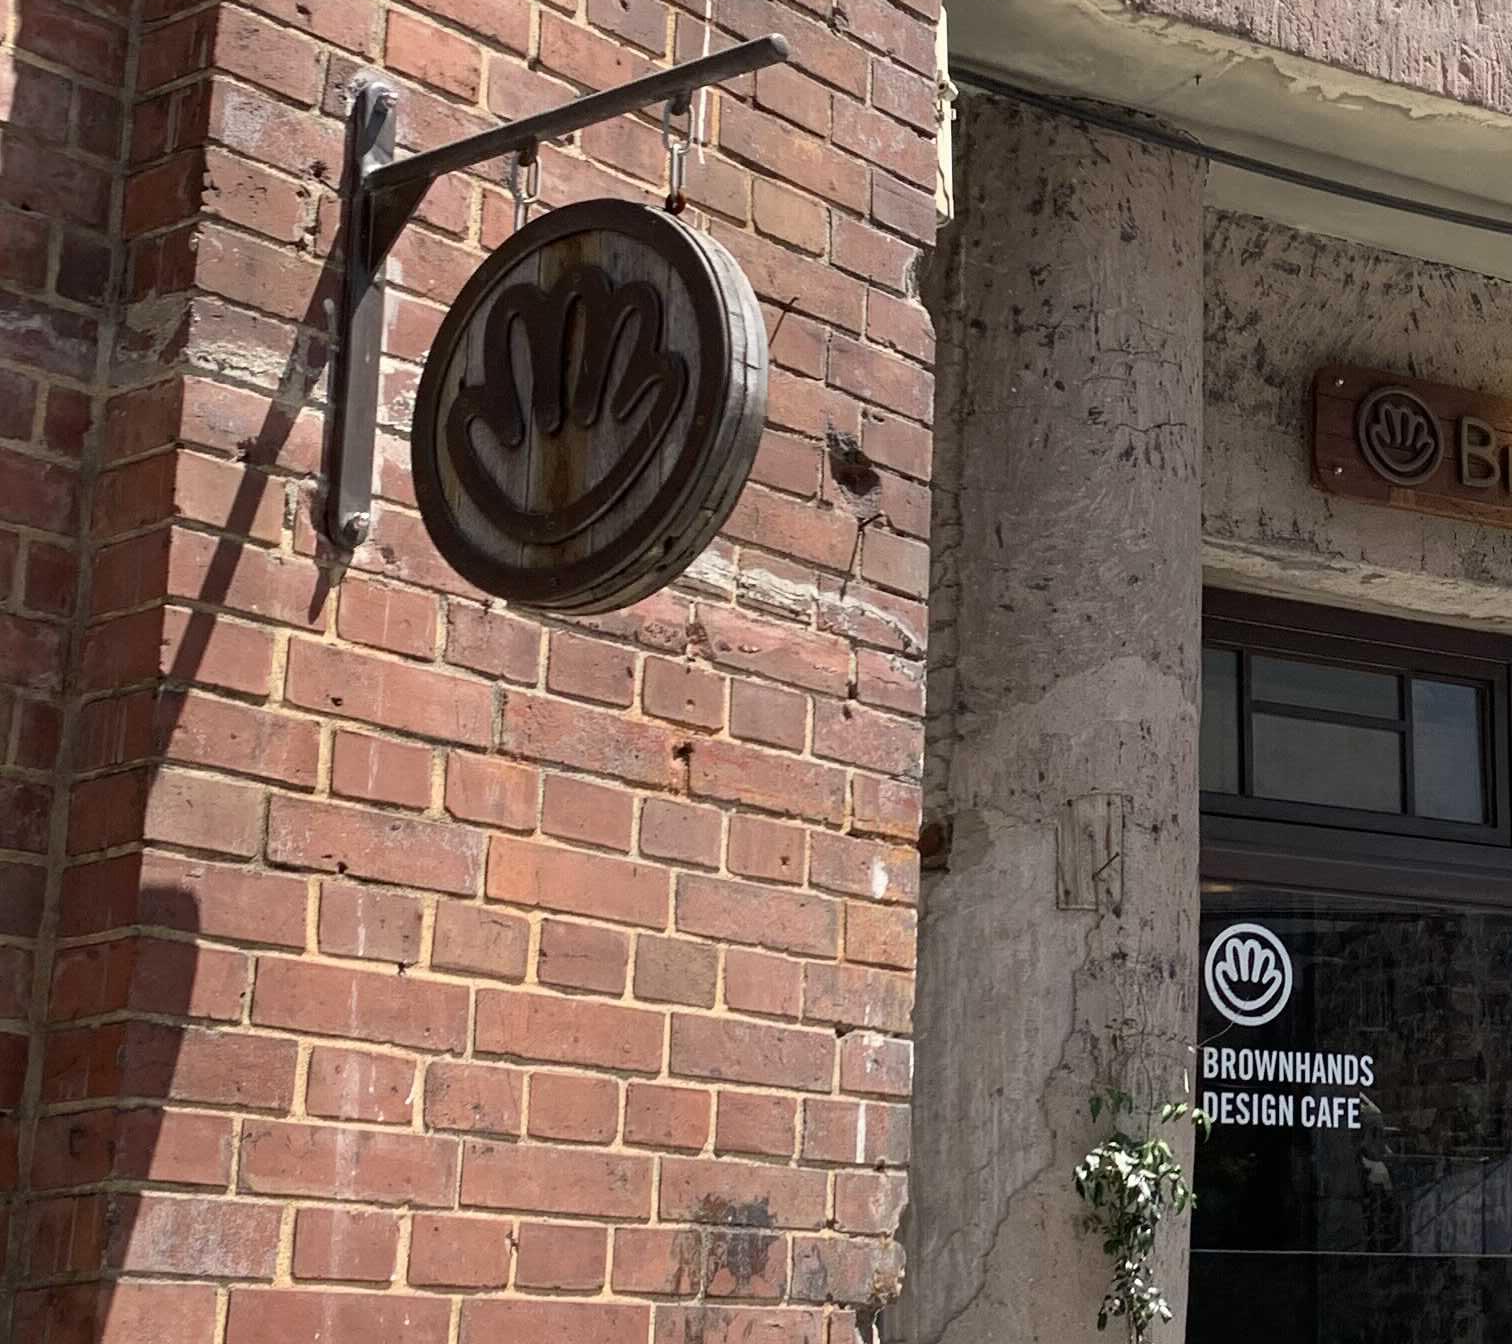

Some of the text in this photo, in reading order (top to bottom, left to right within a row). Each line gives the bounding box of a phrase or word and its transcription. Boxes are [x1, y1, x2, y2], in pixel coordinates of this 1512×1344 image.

[1203, 1047, 1374, 1087] BROWNHANDS
[1203, 1091, 1361, 1129] DESIGN CAFE
